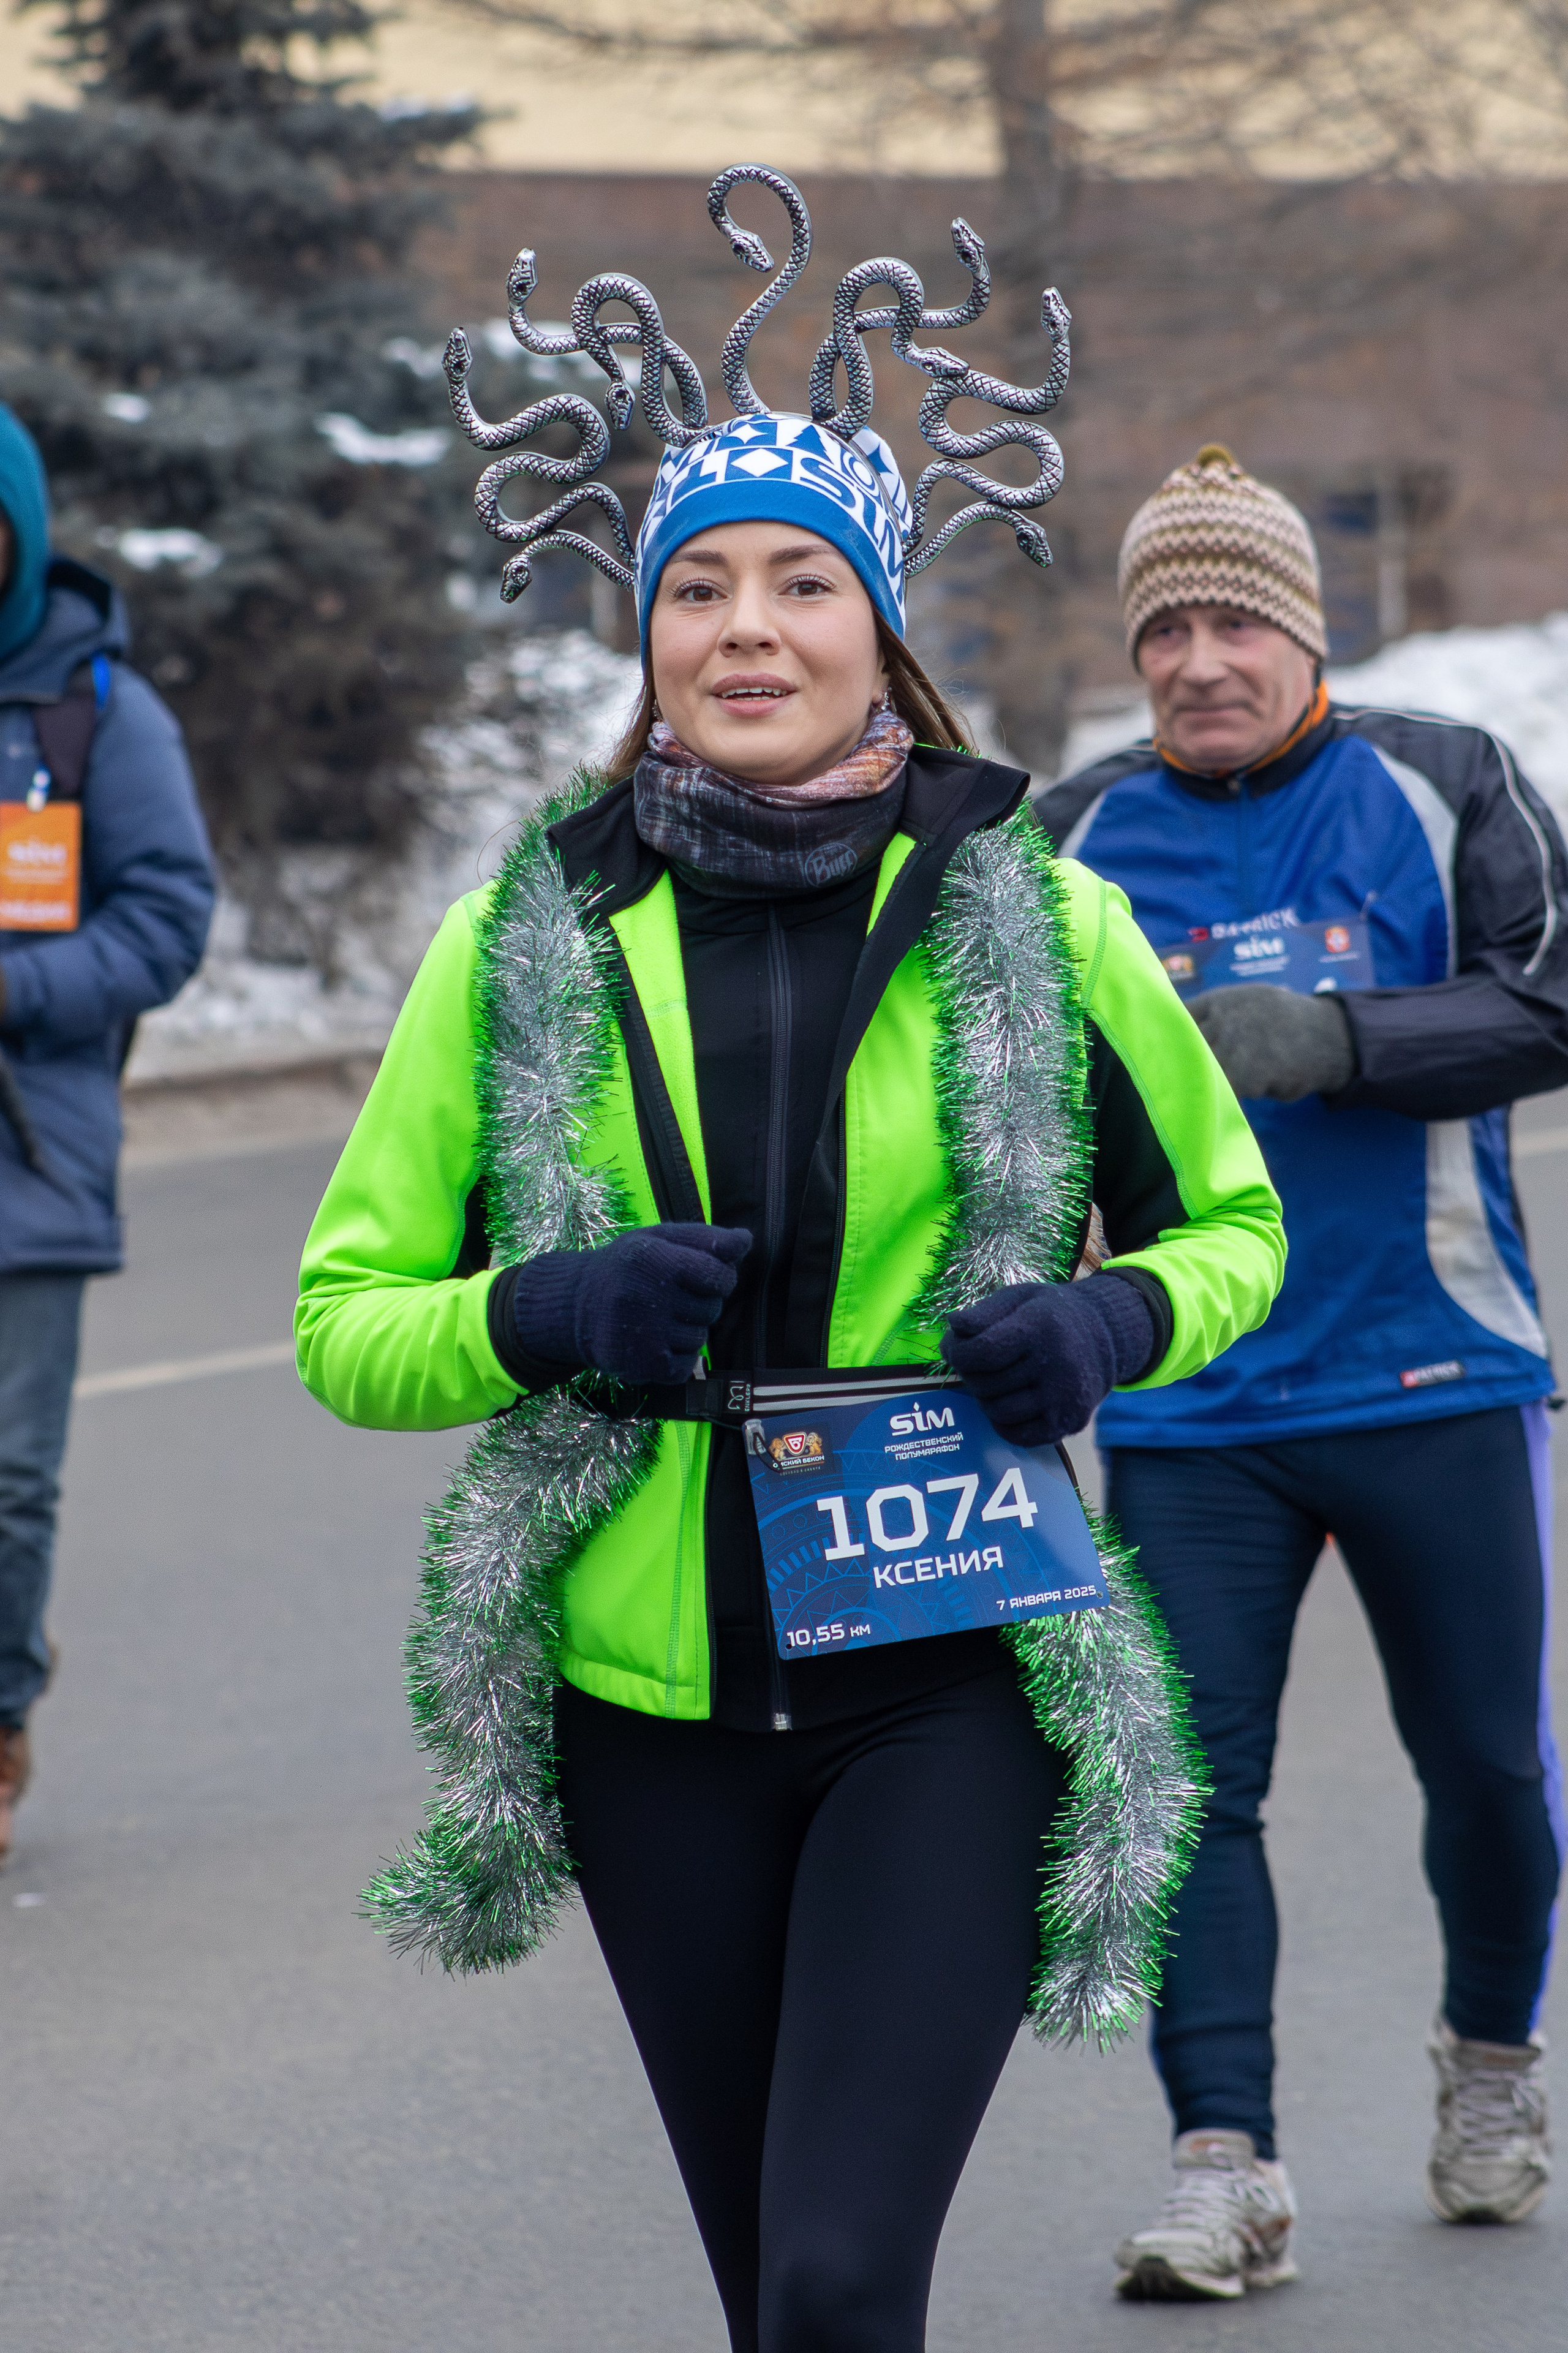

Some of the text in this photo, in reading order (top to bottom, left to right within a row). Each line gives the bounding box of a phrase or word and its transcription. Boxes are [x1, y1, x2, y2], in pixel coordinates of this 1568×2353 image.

[884, 1432, 963, 1453] РОЖДЕСТВЕНСКИЙ
[895, 1443, 960, 1460] ПОЛУМАРАФОН
[802, 1455, 824, 1464] БЕКОН
[816, 1467, 1038, 1561] 1074
[873, 1546, 1004, 1588] КСЕНИЯ
[996, 1585, 1096, 1611] 7 ЯНВАРЯ 2025
[786, 1623, 845, 1647] 10,55
